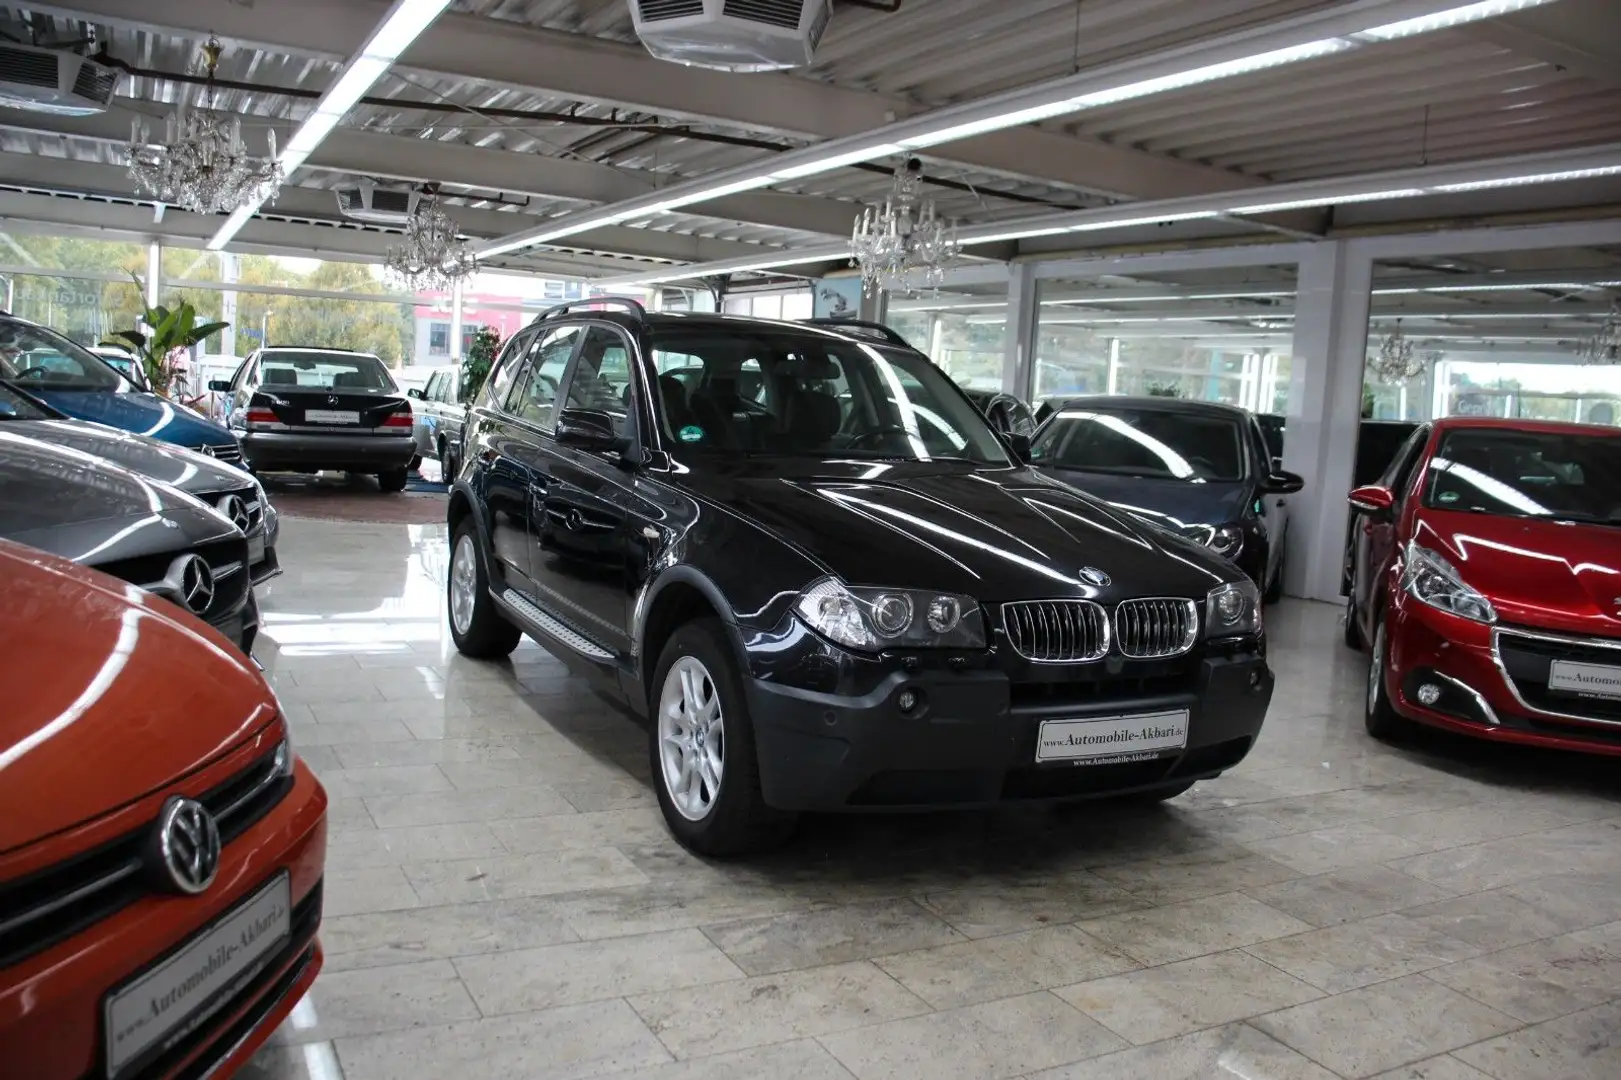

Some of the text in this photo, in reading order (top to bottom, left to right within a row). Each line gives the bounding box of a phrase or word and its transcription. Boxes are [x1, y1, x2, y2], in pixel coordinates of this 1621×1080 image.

[1555, 672, 1621, 686] www.Automo
[1043, 724, 1184, 747] www.Automobile-Akbari.de
[1073, 752, 1160, 767] www.Automobile-Akbari.de
